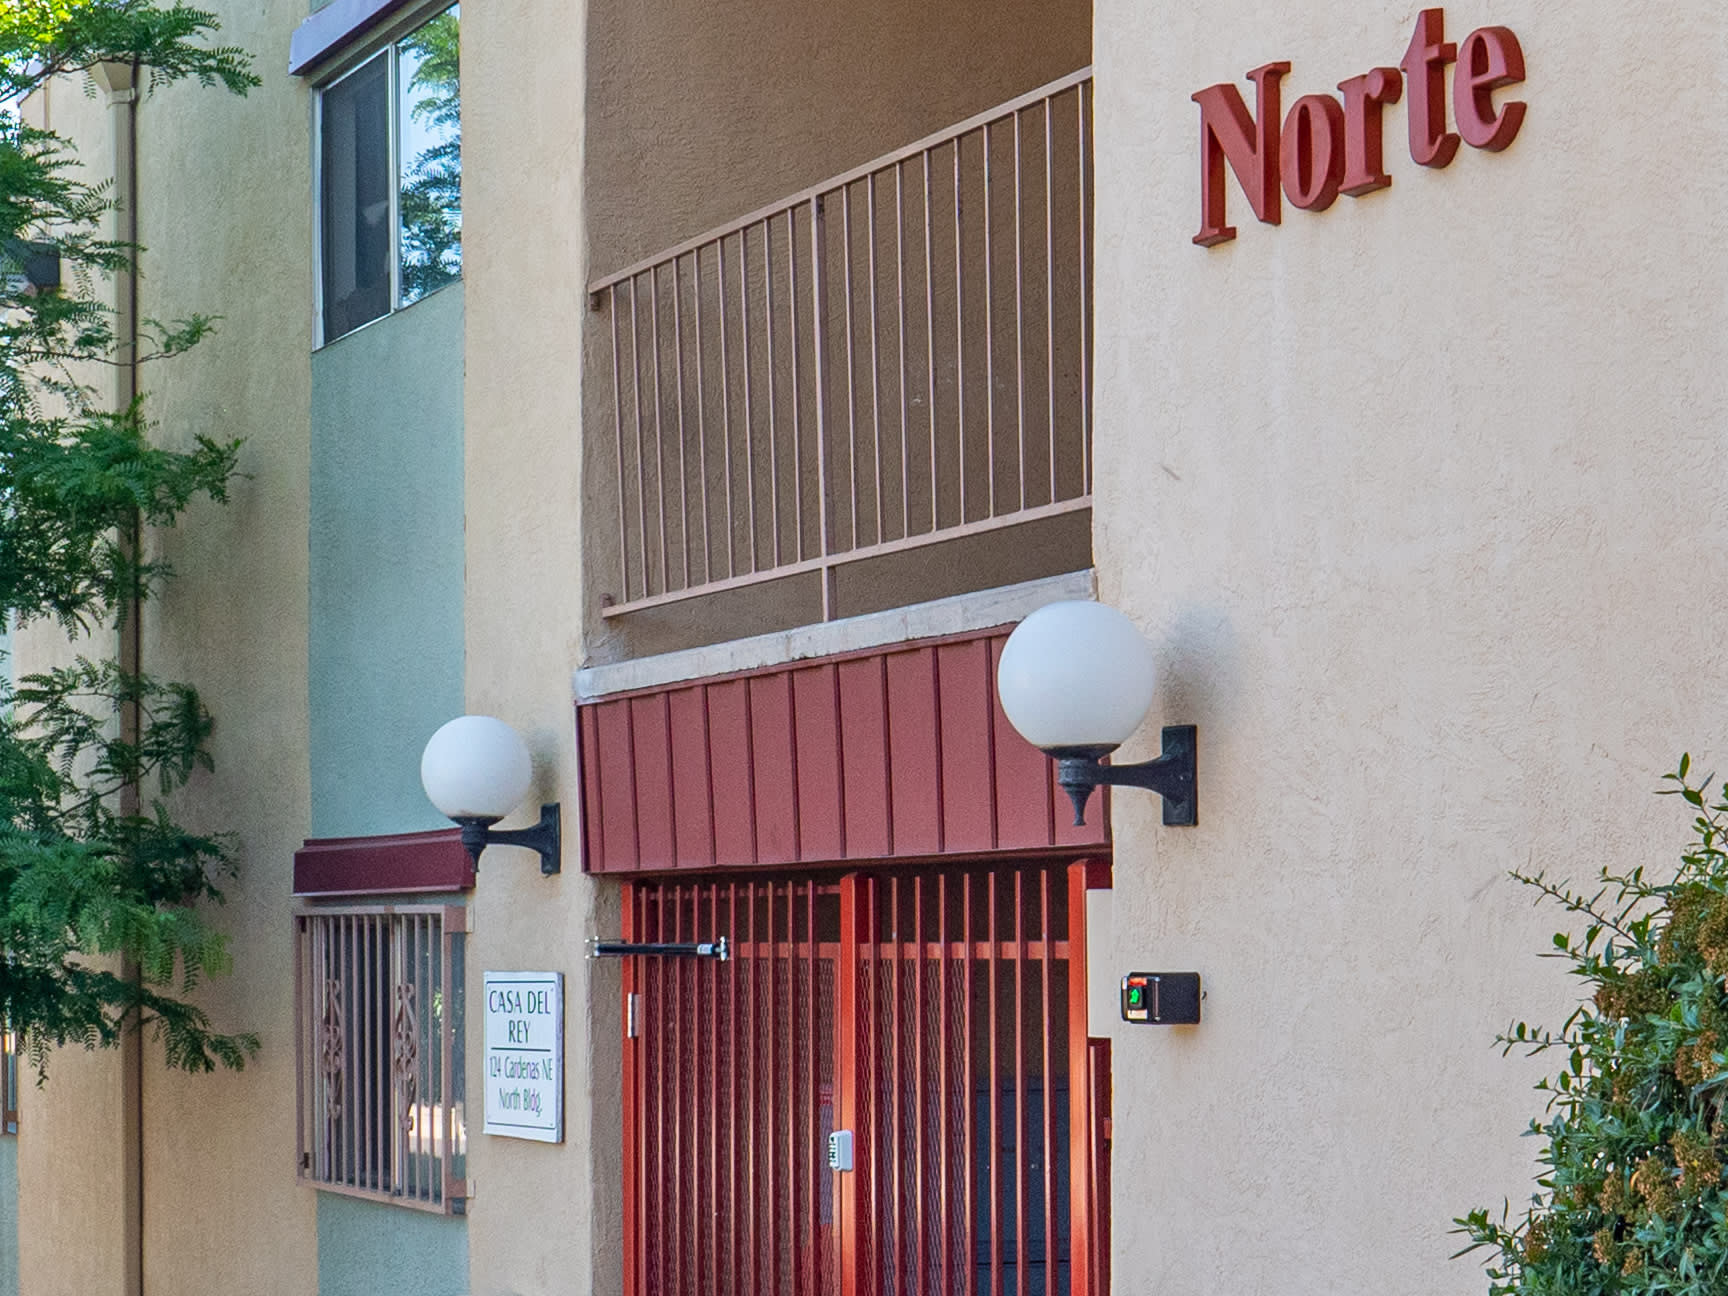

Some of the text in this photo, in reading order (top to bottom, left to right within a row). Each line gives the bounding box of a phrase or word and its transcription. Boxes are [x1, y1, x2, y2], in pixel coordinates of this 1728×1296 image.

[1191, 7, 1528, 248] Norte
[489, 990, 551, 1015] CASA DEL
[508, 1019, 531, 1044] REY
[489, 1056, 553, 1081] 124 Cardenas NE
[498, 1088, 521, 1110] North
